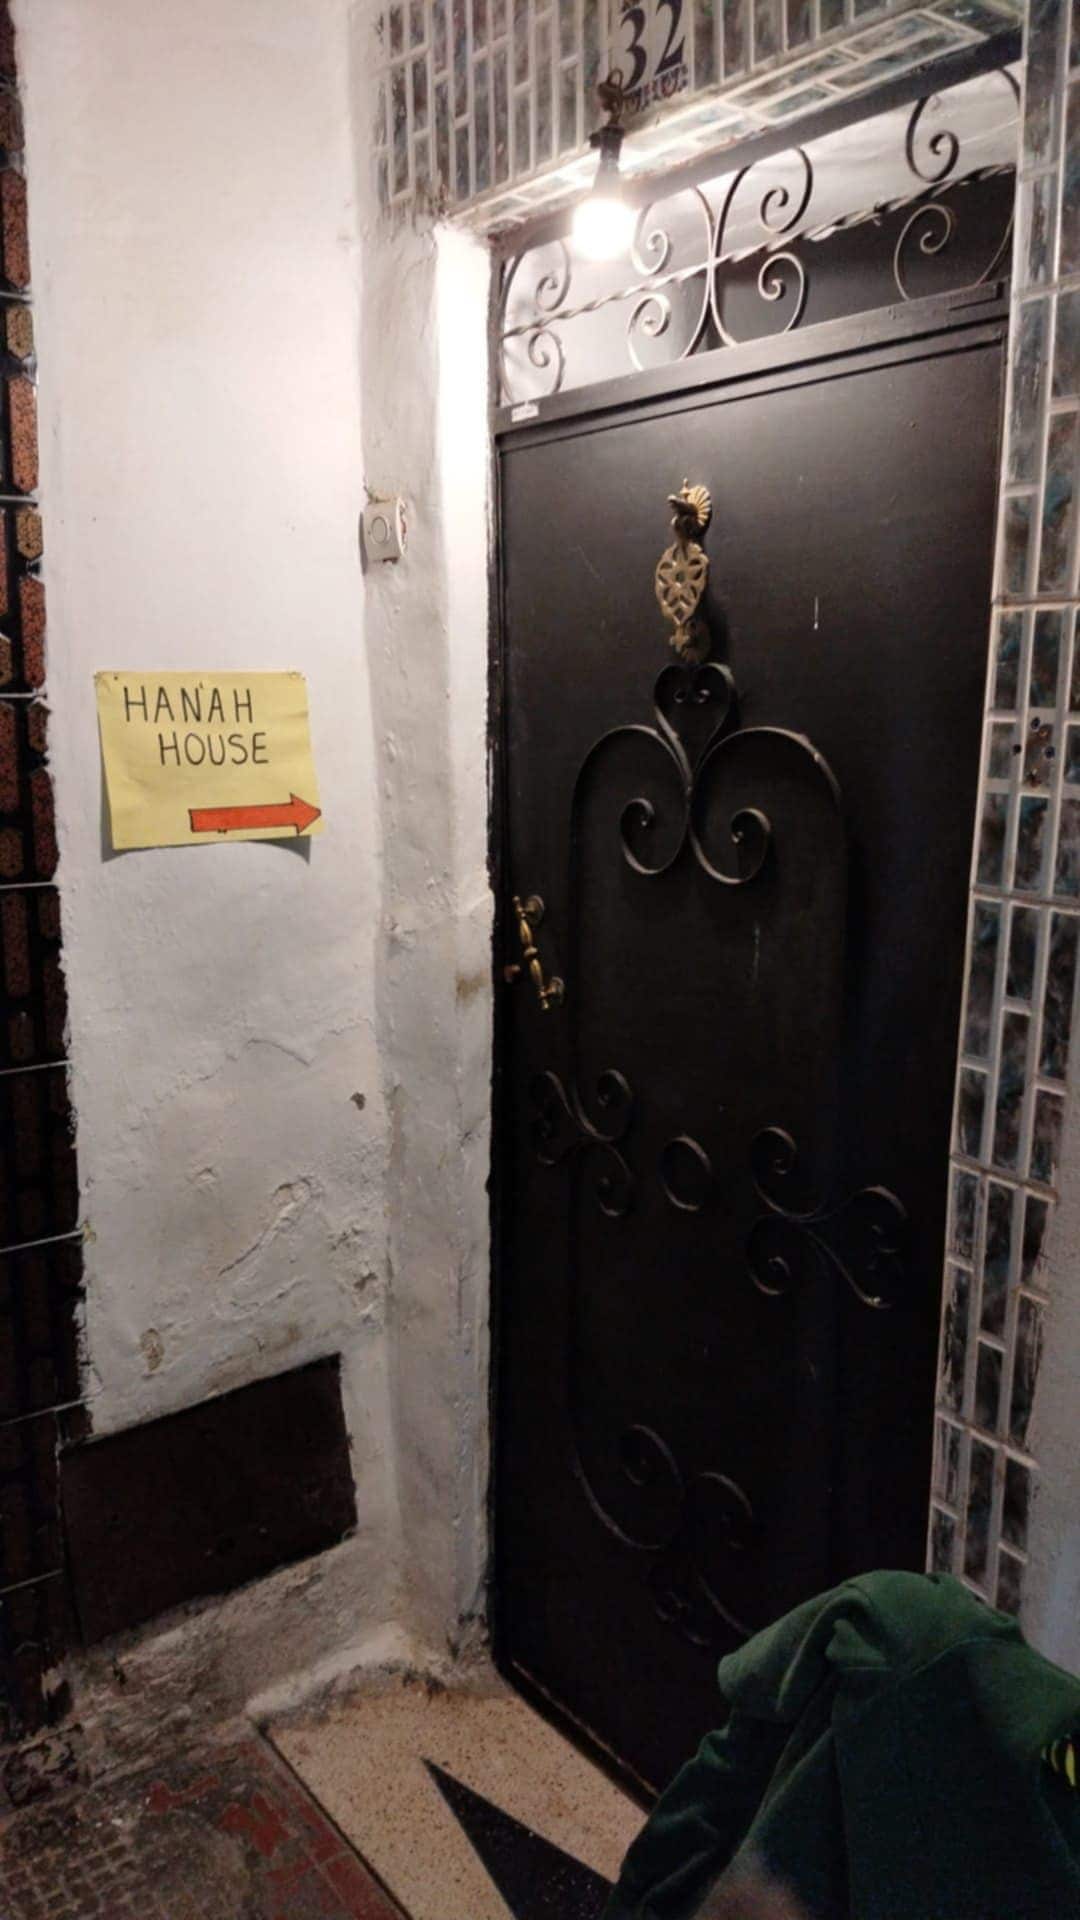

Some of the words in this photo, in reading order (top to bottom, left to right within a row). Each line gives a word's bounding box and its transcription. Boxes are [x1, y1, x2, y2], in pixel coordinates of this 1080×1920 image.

[620, 0, 685, 94] 32
[124, 685, 253, 723] HANAH
[158, 731, 269, 766] HOUSE
